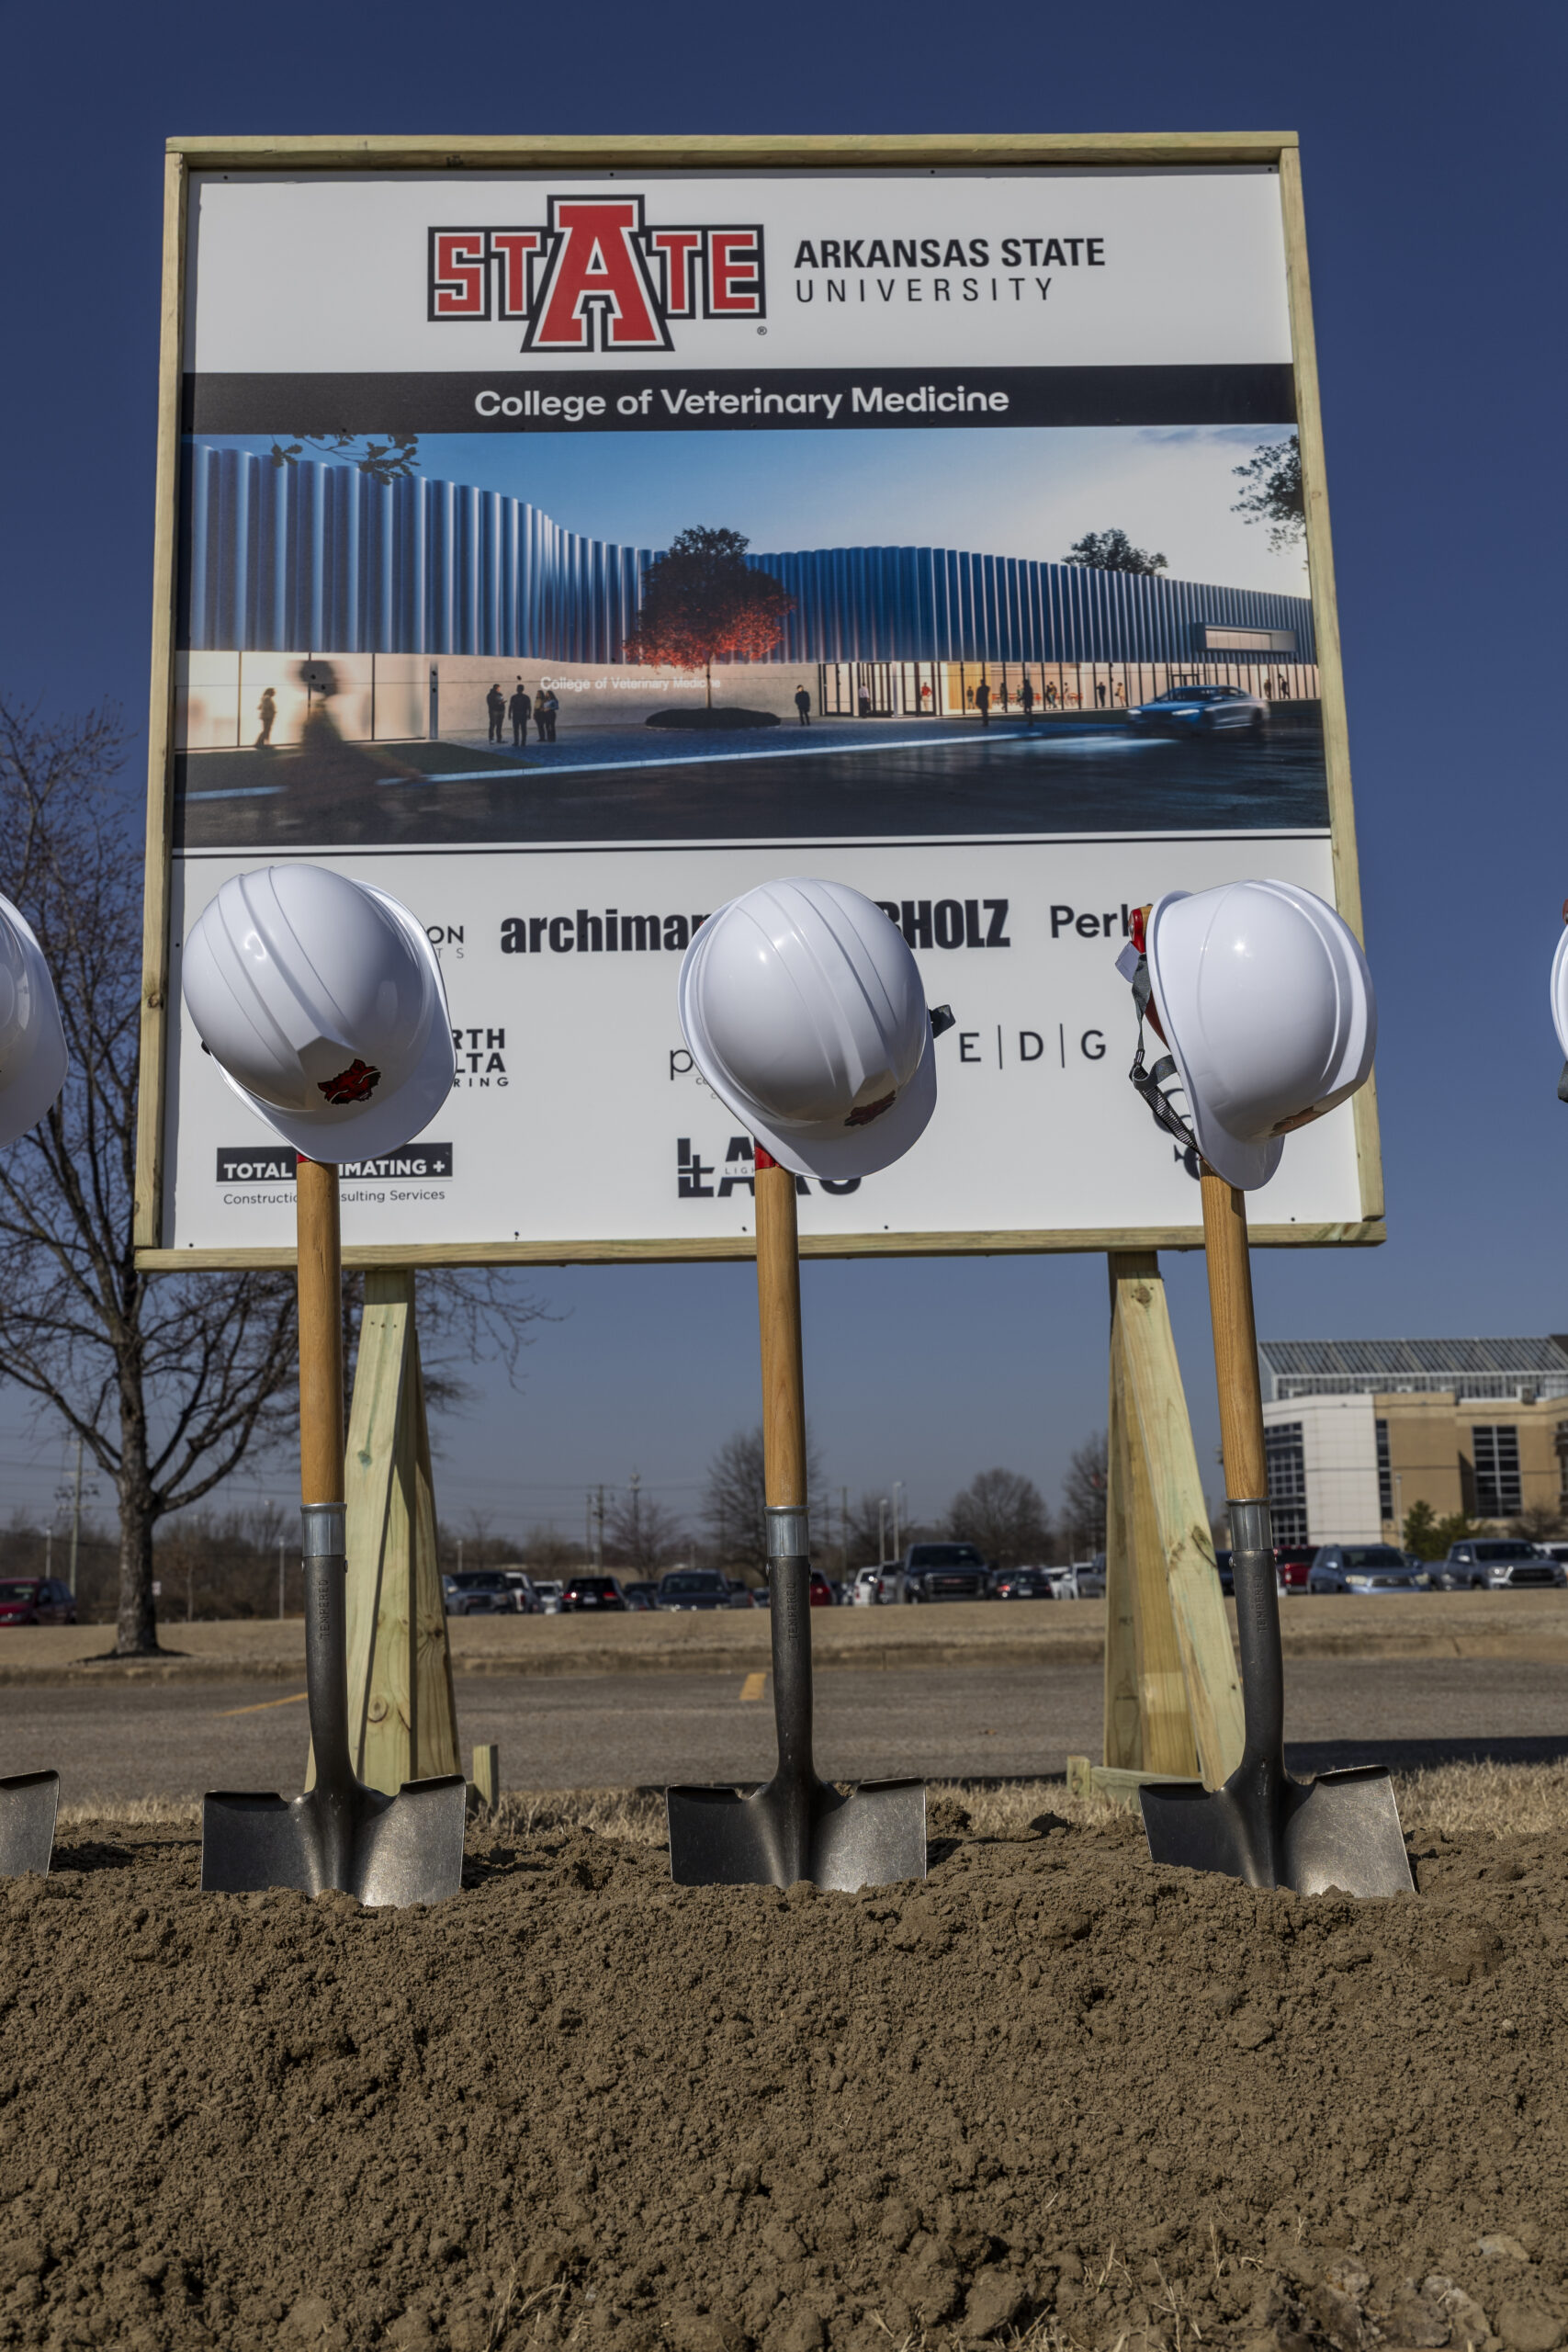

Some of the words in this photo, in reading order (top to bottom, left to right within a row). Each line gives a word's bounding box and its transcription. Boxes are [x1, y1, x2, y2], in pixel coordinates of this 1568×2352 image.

[794, 238, 991, 268] ARKANSAS
[1000, 237, 1106, 266] STATE
[427, 195, 767, 353] STATE
[795, 277, 1053, 303] UNIVERSITY
[474, 390, 606, 422] College
[616, 389, 653, 414] of
[660, 387, 843, 419] Veterinary
[852, 385, 1010, 413] Medicine
[540, 676, 590, 692] College
[594, 676, 607, 689] of
[611, 677, 670, 691] Veterinary
[223, 1162, 293, 1179] TOTAL
[389, 1188, 446, 1201] Services
[318, 1579, 331, 1640] TEMPERED
